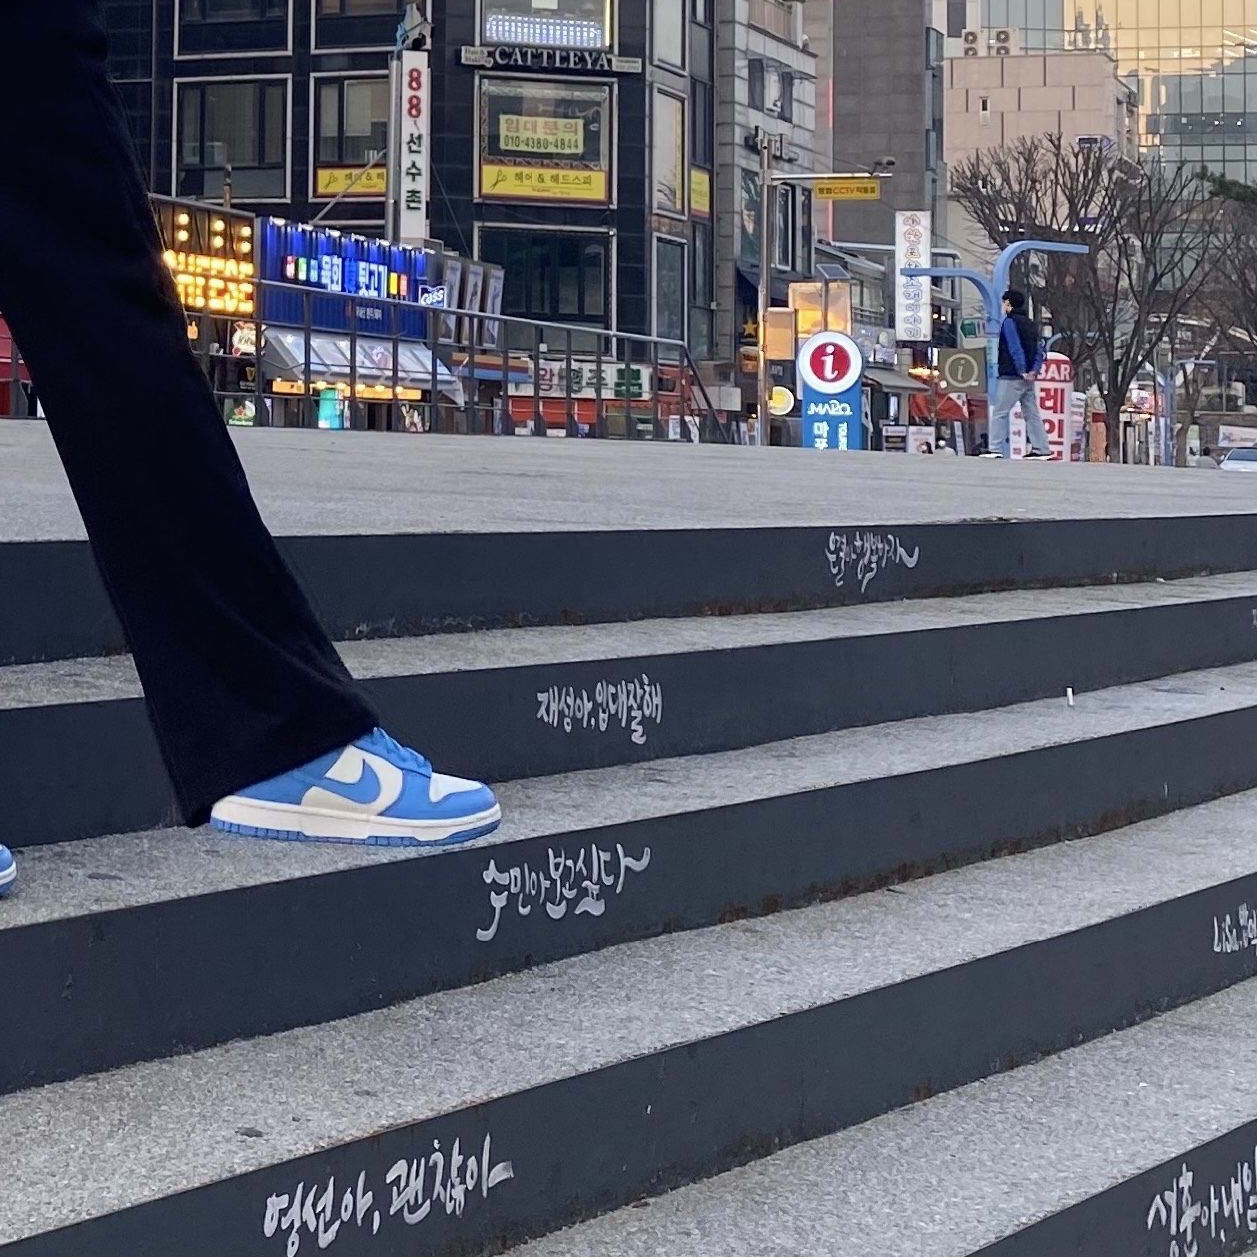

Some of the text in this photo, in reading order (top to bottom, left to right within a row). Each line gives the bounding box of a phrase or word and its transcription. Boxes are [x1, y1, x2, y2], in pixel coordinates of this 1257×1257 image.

[494, 45, 613, 71] CATTLEYA
[504, 117, 579, 136] 임대문의
[504, 136, 579, 150] 010-4380-4844
[405, 132, 424, 211] 선수촌
[514, 171, 533, 184] 헤어
[537, 173, 546, 184] &
[385, 1131, 515, 1226] 괜찮아
